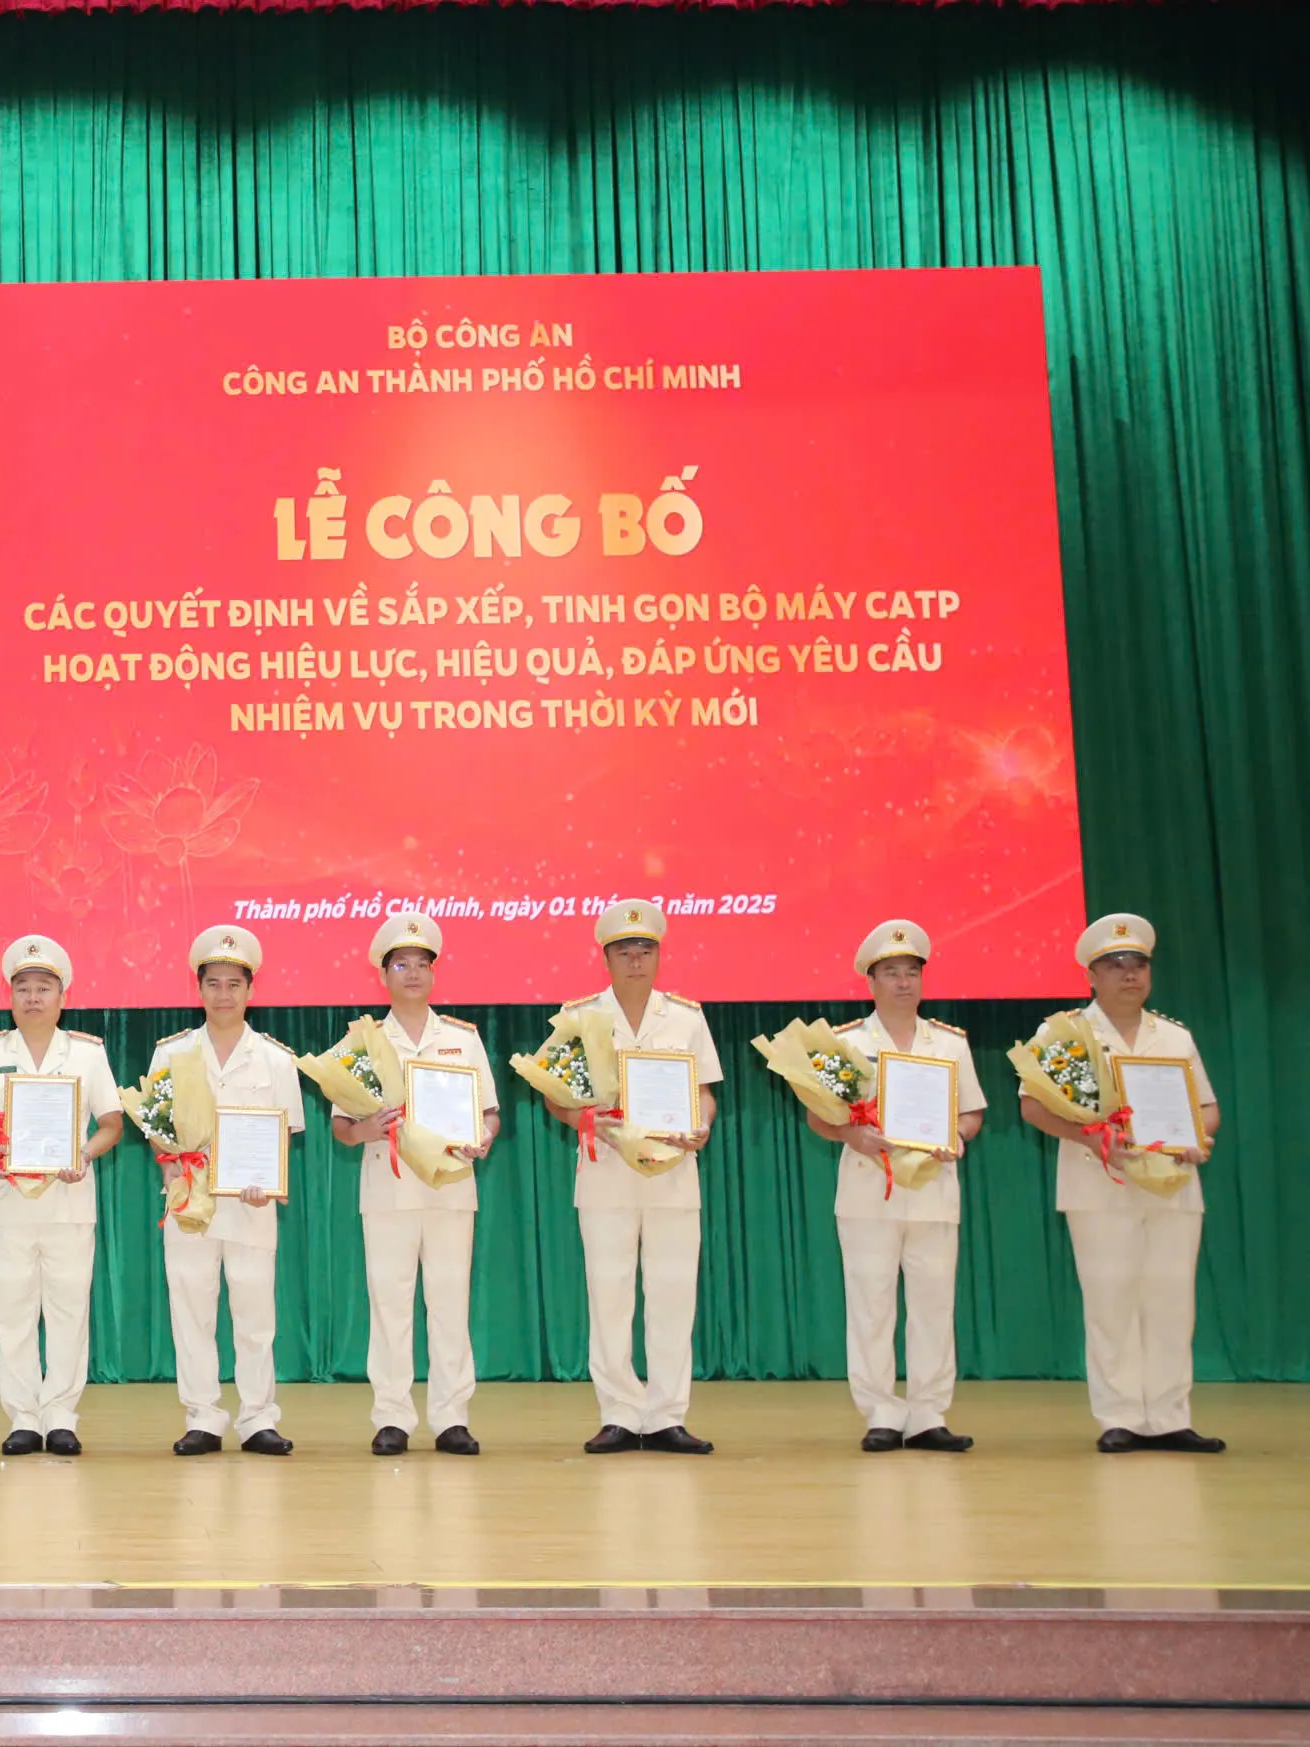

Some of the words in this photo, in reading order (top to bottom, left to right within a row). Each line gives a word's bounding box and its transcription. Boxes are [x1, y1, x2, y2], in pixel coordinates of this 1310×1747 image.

[387, 318, 428, 356] BỘ
[435, 317, 520, 349] CÔNG
[529, 320, 573, 348] AN
[222, 364, 308, 396] CÔNG
[315, 371, 359, 394] AN
[366, 362, 473, 393] THÀNH
[482, 356, 546, 392] PHỐ
[553, 353, 596, 391] HỒ
[603, 359, 655, 390] CHÍ
[662, 364, 741, 390] MINH
[273, 466, 348, 561] LỄ
[365, 479, 581, 560] CÔNG
[598, 464, 704, 557] BỐ
[23, 593, 96, 632] CÁC
[103, 587, 221, 638] QUYẾT
[228, 597, 314, 636] ĐỊNH
[322, 581, 370, 627] VỀ
[378, 581, 449, 626] SẮP
[456, 582, 534, 628] XẾP,
[542, 593, 626, 624] TINH
[634, 592, 710, 631] GỌN
[718, 584, 766, 631] BỘ
[775, 583, 857, 622] MÁY
[865, 589, 961, 621] CATP
[43, 653, 143, 691] HOẠT
[149, 644, 251, 690] ĐỘNG
[260, 641, 341, 689] HIỆU
[350, 648, 428, 688] LỰC,
[436, 640, 519, 686] HIỆU
[526, 636, 615, 685] QUẢ,
[621, 636, 696, 676] ĐÁP
[704, 636, 781, 675] ỨNG
[788, 636, 859, 674] YÊU
[867, 627, 942, 672] CẦU
[230, 694, 344, 740] NHIỆM
[352, 701, 402, 739] VỤ
[410, 698, 533, 730] TRONG
[541, 689, 625, 729] THỜI
[634, 689, 684, 727] KỲ
[691, 687, 758, 727] MỚI
[234, 897, 301, 920] Thành
[303, 892, 352, 923] phố
[350, 891, 383, 918] Hồ
[385, 895, 424, 917] Chí
[425, 896, 485, 919] Minh,
[490, 894, 546, 921] ngày
[548, 896, 576, 917] 01
[666, 893, 715, 915] năm
[717, 894, 777, 915] 2025
